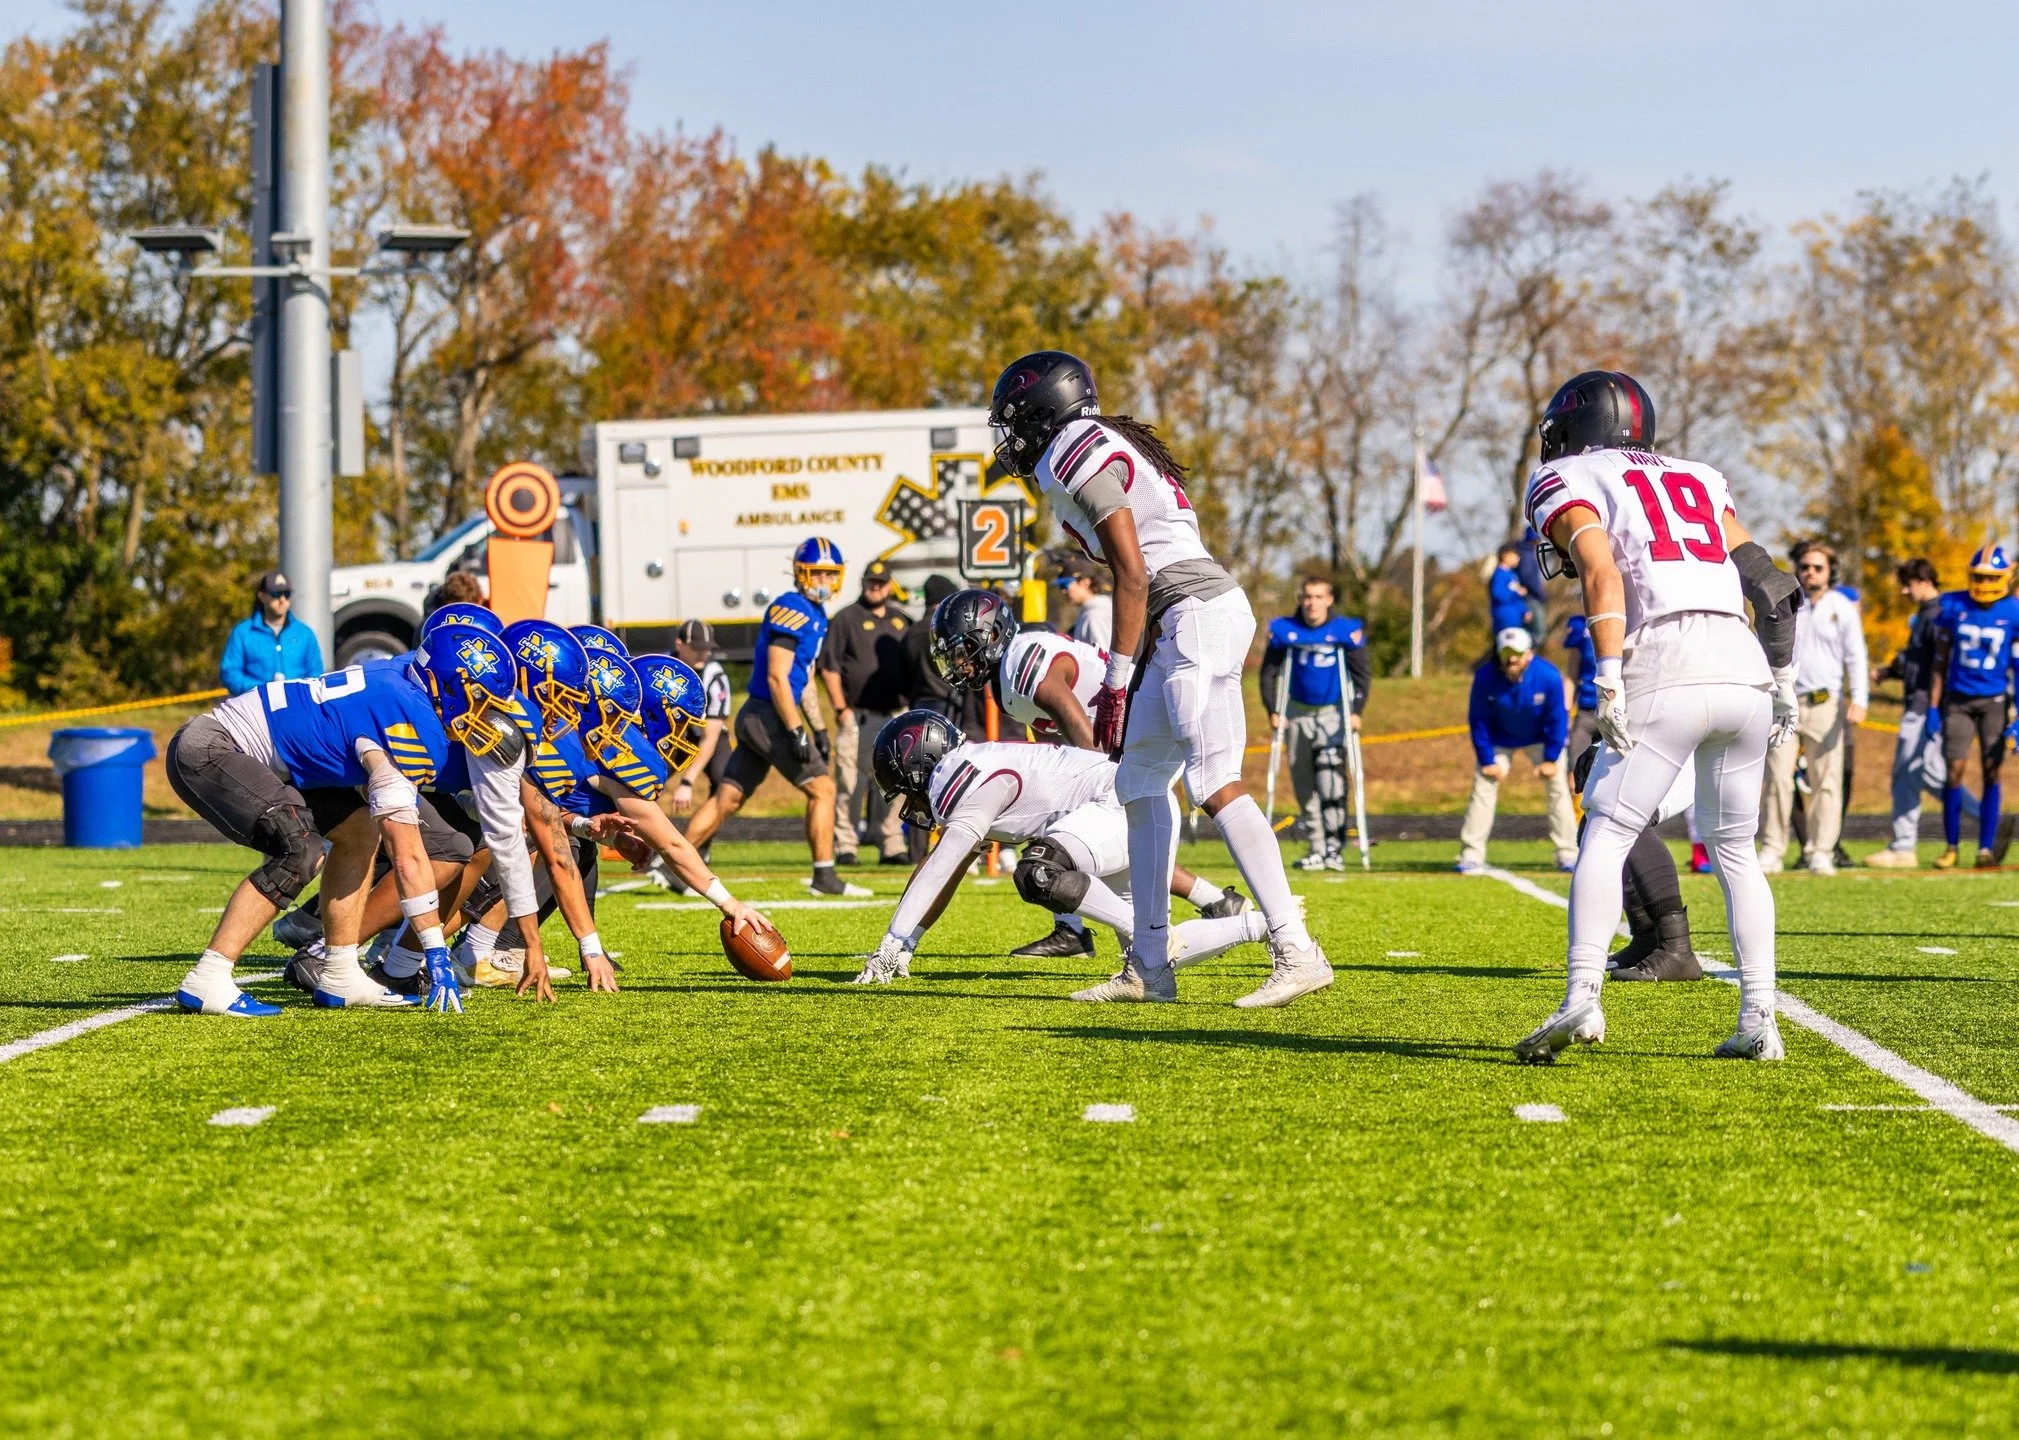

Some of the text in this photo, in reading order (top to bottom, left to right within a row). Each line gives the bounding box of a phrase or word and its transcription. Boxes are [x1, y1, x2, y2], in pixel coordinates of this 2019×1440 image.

[1622, 429, 1630, 437] 19
[689, 452, 885, 477] WOODFORD COUNTY
[771, 482, 811, 502] EMS
[735, 509, 845, 528] AMBULANCE
[1622, 469, 1728, 565] 19
[972, 504, 1010, 566] 2
[1957, 622, 2006, 670] 27
